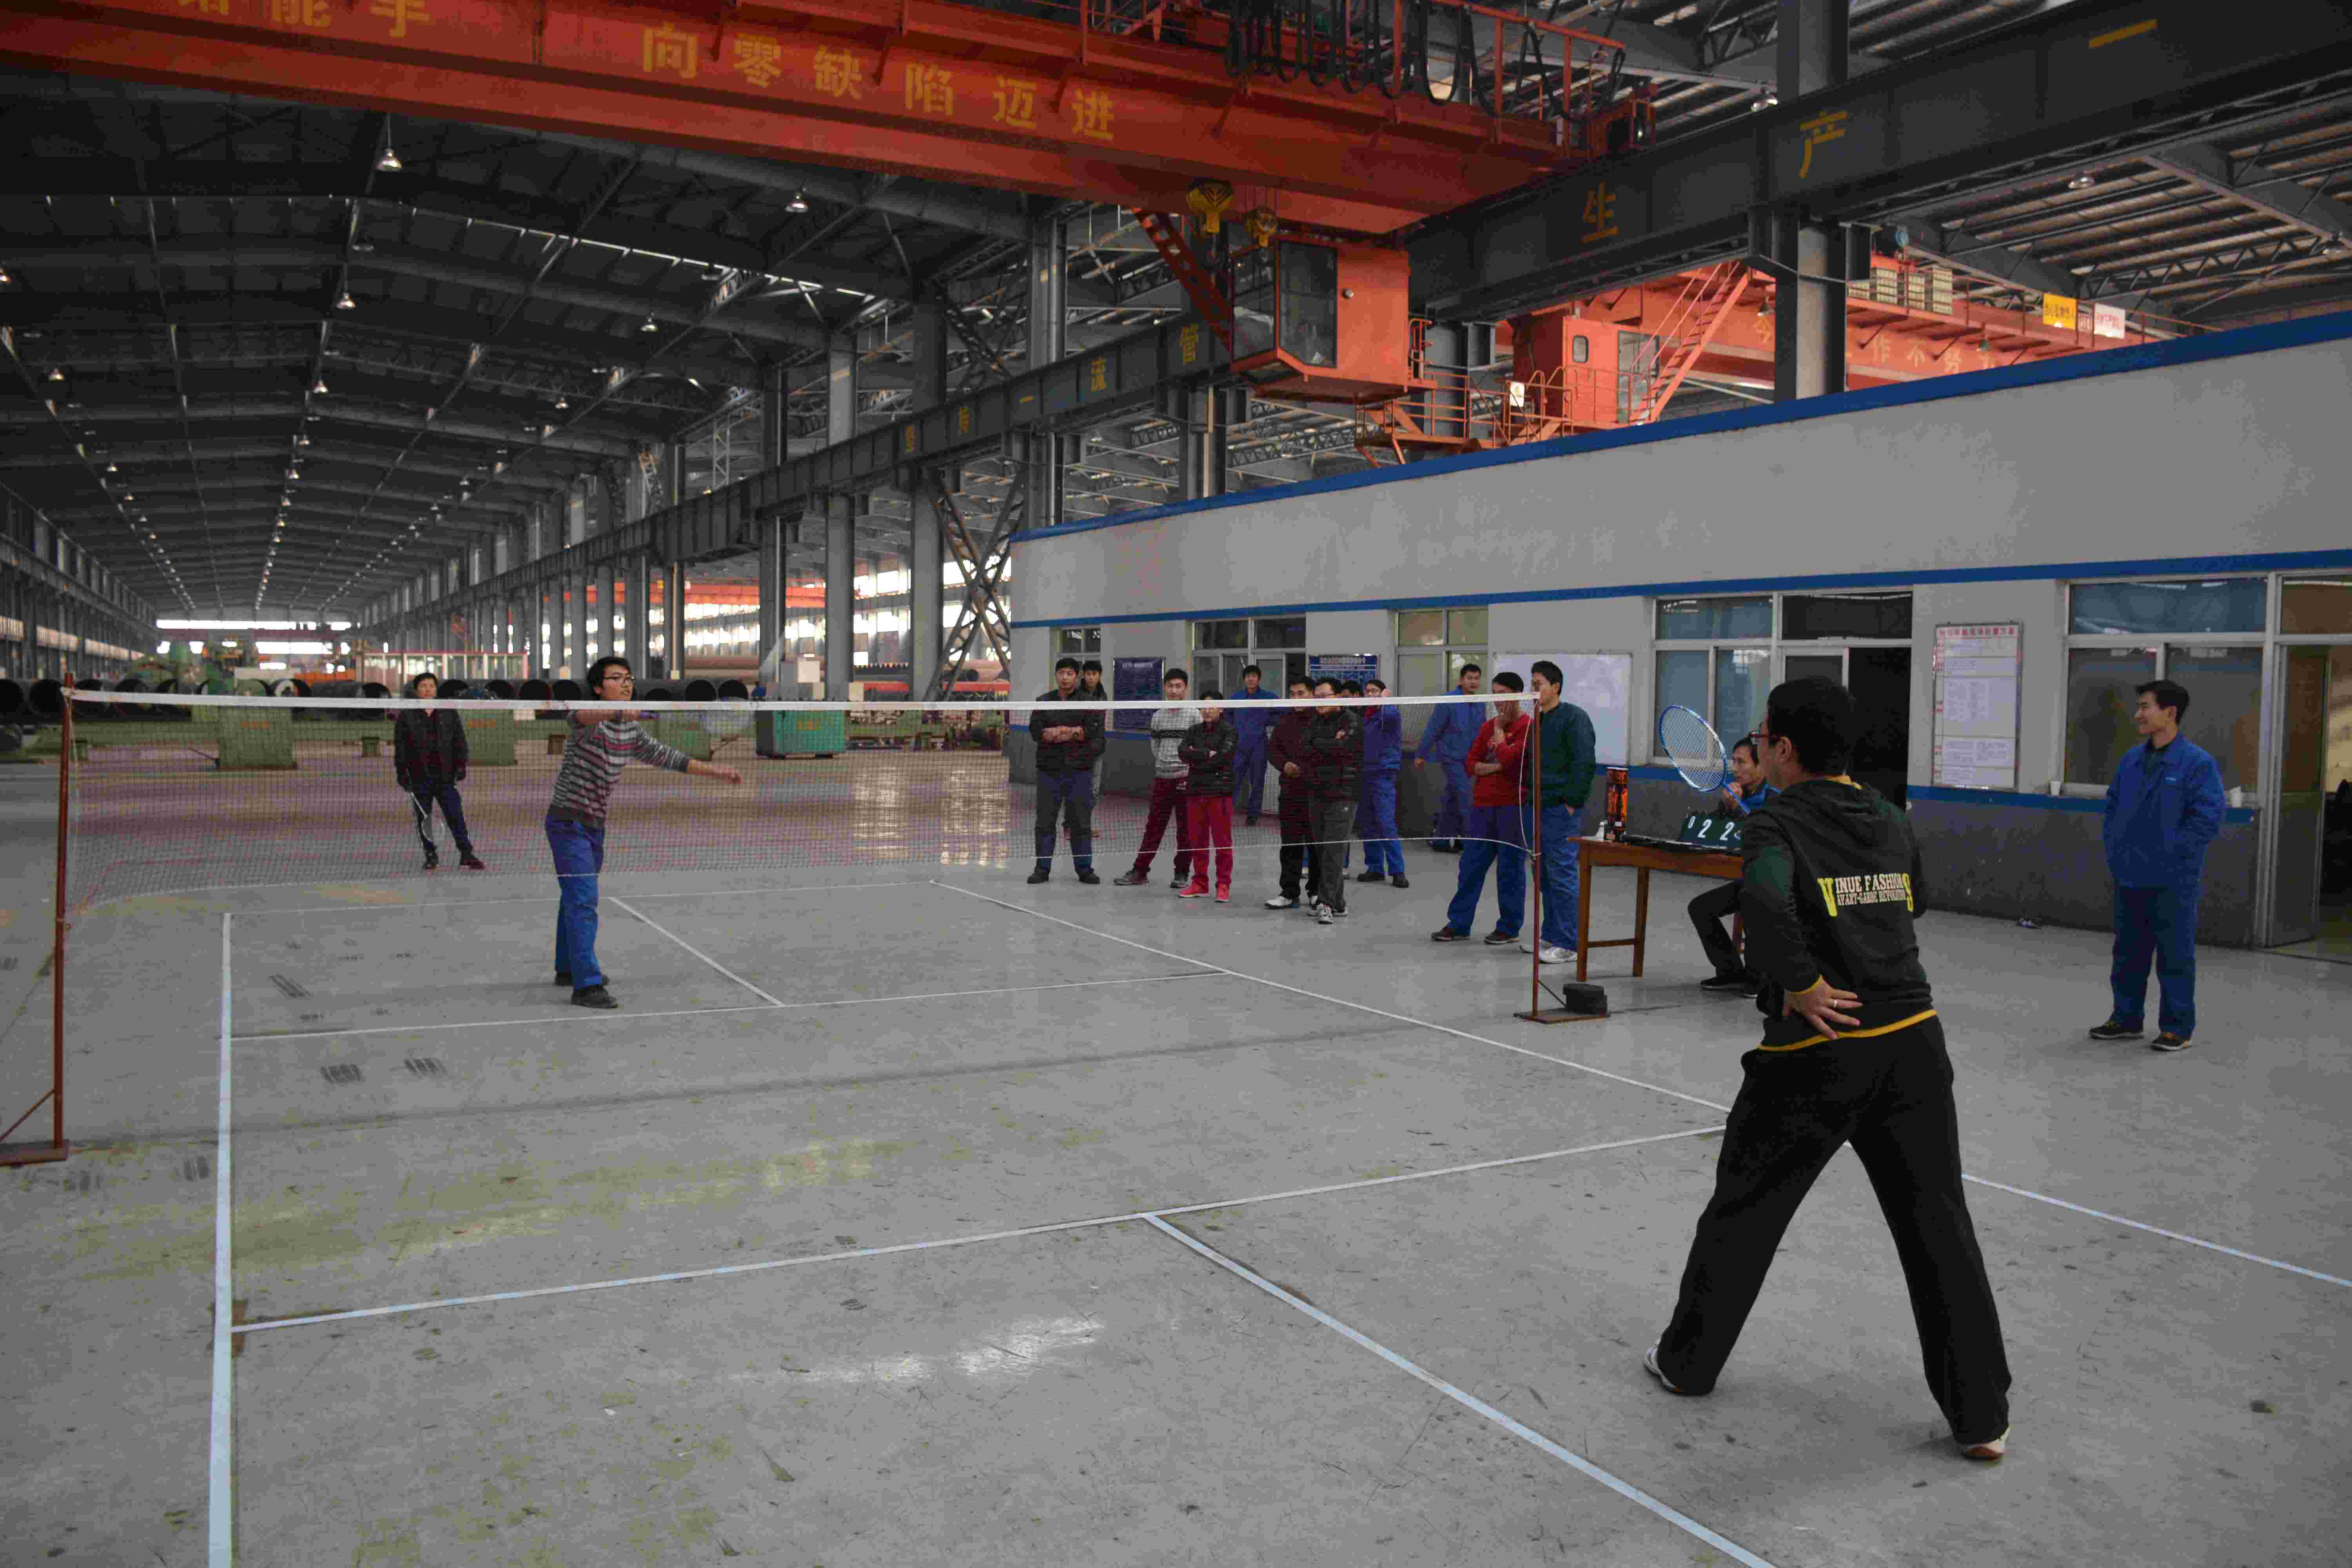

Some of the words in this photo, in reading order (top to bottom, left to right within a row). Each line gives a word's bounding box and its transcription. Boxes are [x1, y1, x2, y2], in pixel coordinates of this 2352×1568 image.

[641, 21, 1115, 142] 向零缺陷迈进
